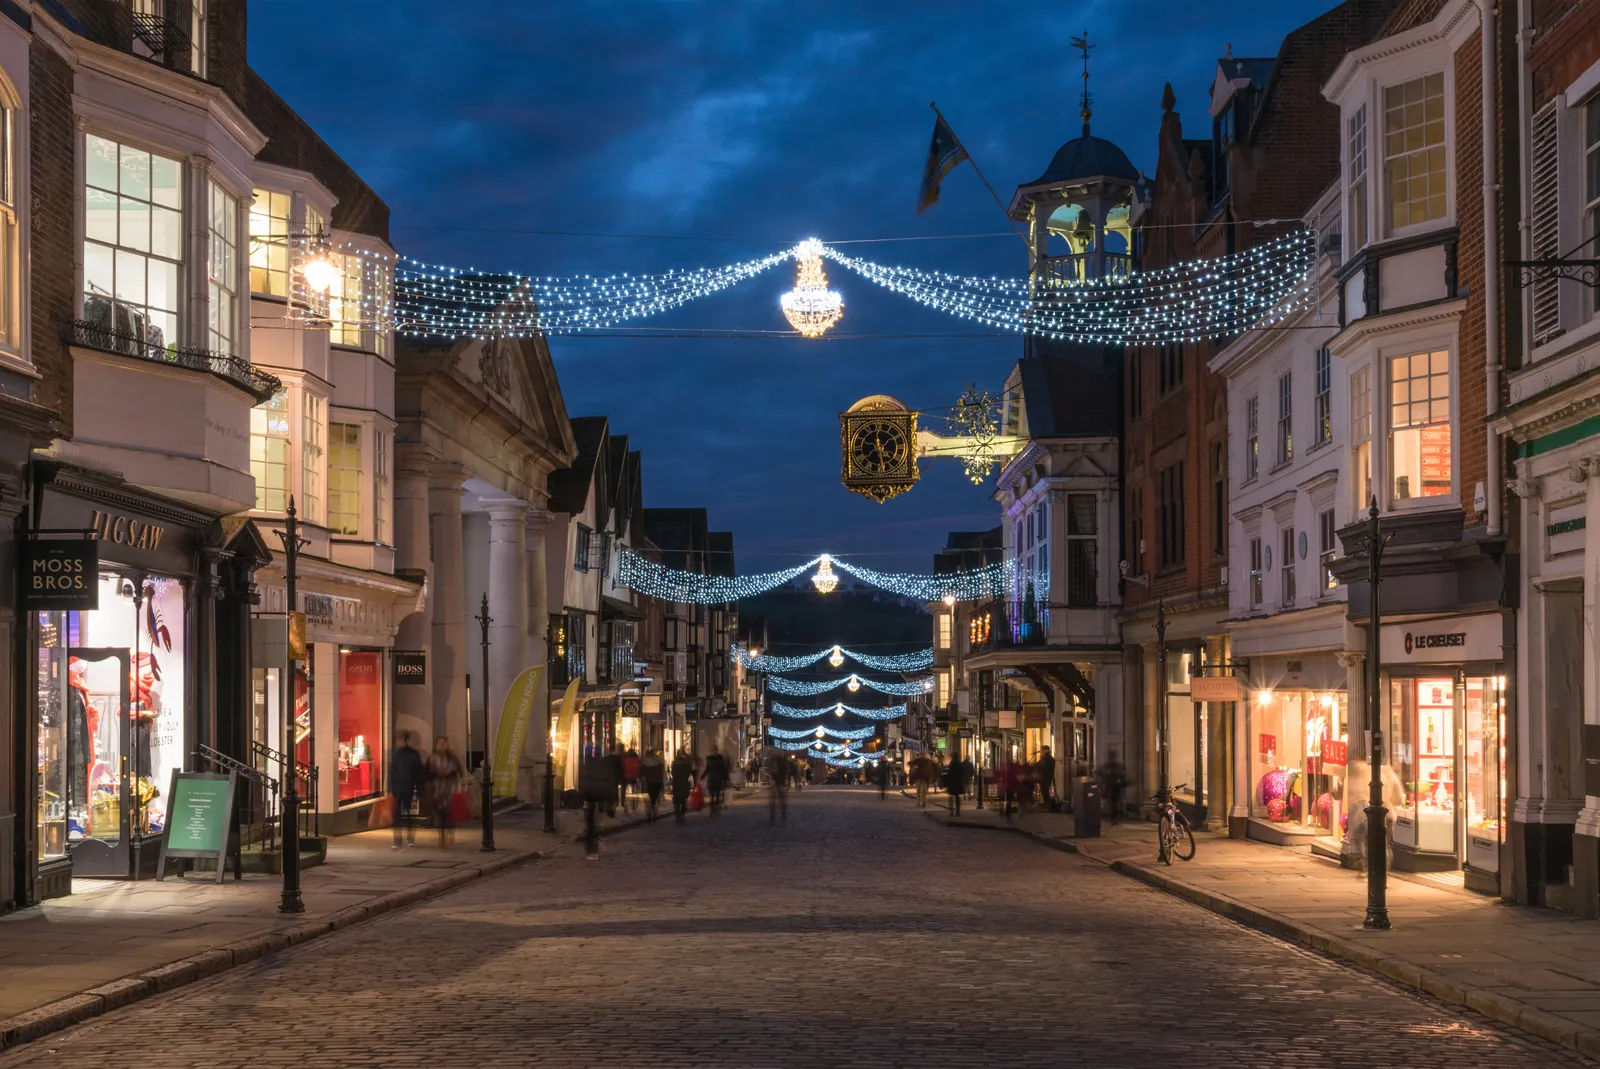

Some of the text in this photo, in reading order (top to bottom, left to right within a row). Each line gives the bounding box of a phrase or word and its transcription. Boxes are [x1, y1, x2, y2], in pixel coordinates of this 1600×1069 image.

[87, 510, 164, 551] JIGSAW
[33, 559, 83, 572] MOSS
[33, 575, 88, 589] BROS.
[1415, 633, 1466, 649] LE CREUSET
[398, 664, 423, 673] BOSS
[507, 671, 537, 765] OPEN FOR BUSINESS
[150, 735, 173, 747] LOBSTER
[1325, 744, 1345, 761] SALE
